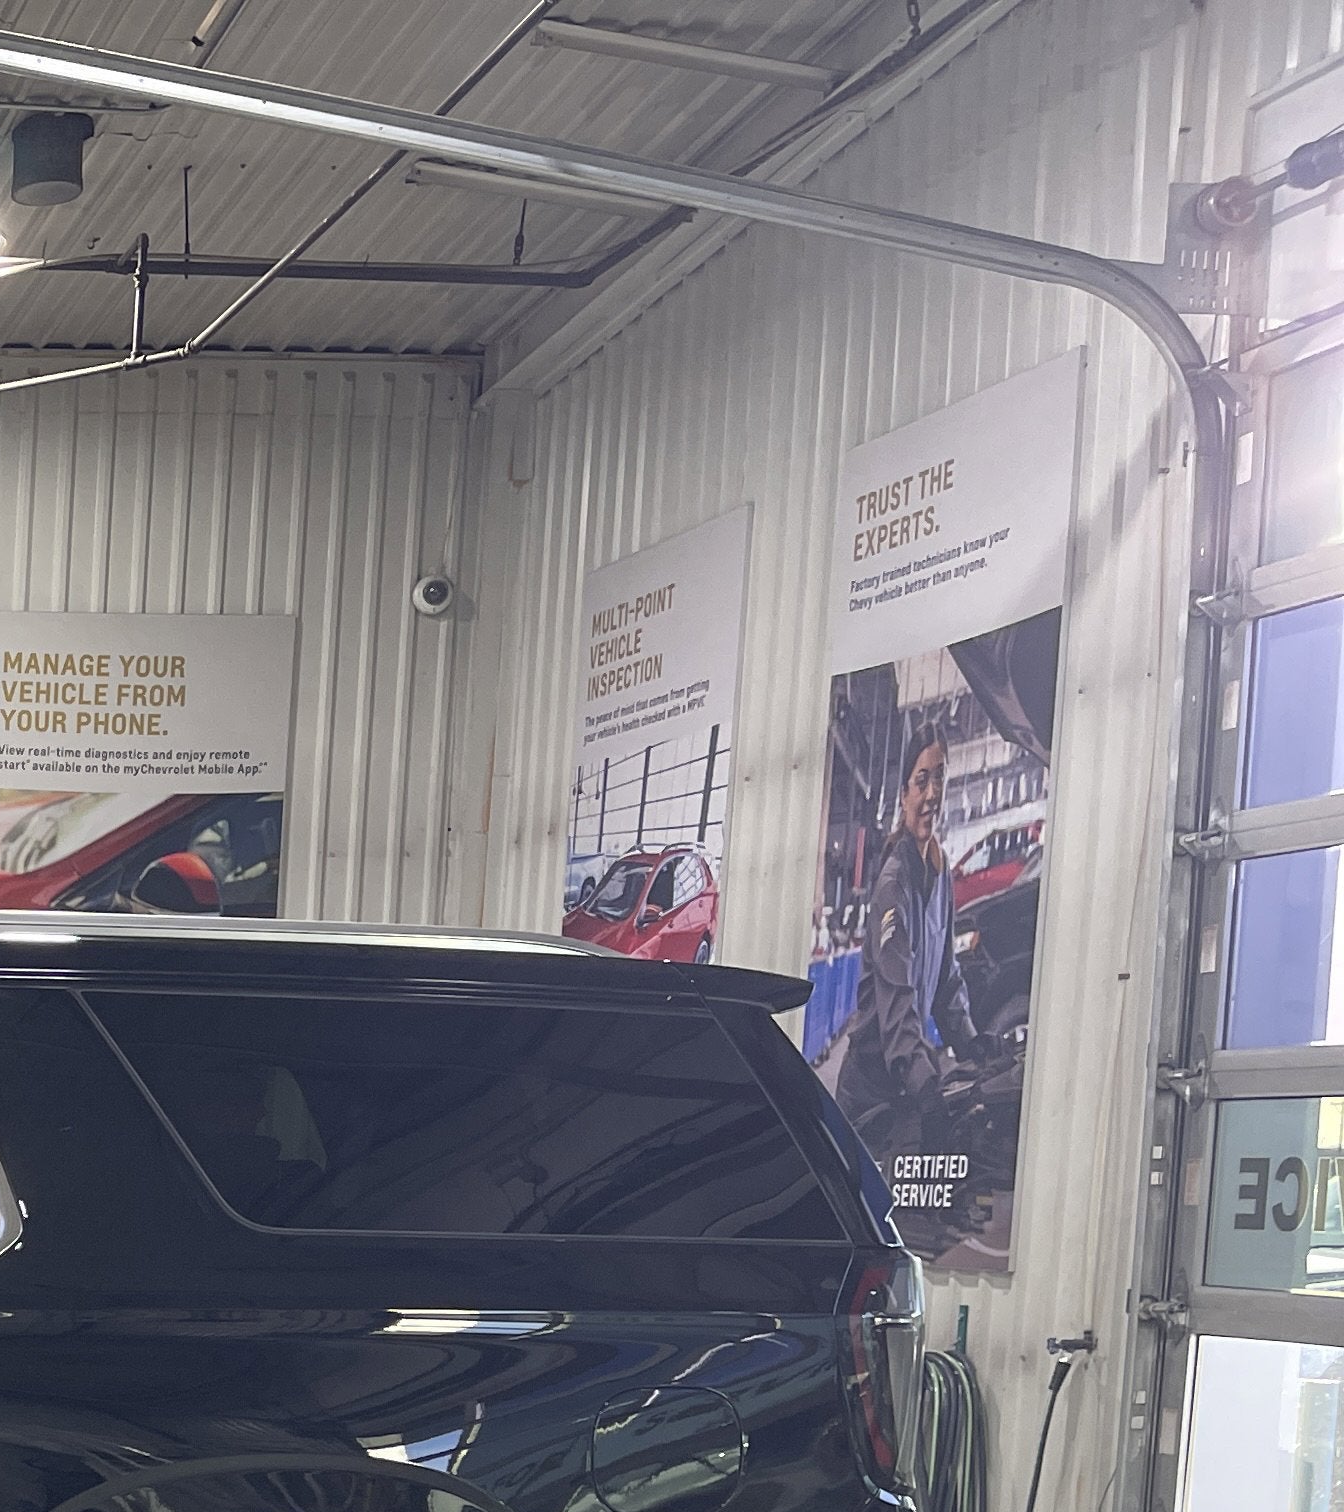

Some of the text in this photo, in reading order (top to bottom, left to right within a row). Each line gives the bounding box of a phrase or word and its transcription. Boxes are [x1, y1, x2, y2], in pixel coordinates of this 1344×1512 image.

[856, 458, 954, 524] TRUST THE
[854, 505, 940, 562] EXPERTS.
[850, 528, 1010, 593] Factory trained technicians know your
[932, 570, 952, 586] than
[592, 583, 675, 638] MULTI-POINT
[590, 628, 642, 669] VEHICLE
[3, 652, 186, 678] MANAGE YOUR
[587, 653, 663, 701] INSPECTION
[1, 680, 186, 707] VEHICLE FROM
[0, 708, 168, 736] YOUR PHONE.
[28, 746, 81, 758] real-time
[84, 748, 148, 761] diagnostics
[152, 749, 172, 760] and
[176, 750, 206, 762] enjoy
[210, 750, 250, 760] remote
[32, 761, 82, 772] available
[85, 764, 98, 774] on
[102, 763, 120, 774] the
[124, 764, 194, 776] myChevrolet
[198, 764, 234, 774] Mobile
[894, 1154, 968, 1178] CERTIFIED
[892, 1184, 954, 1208] SERVICE
